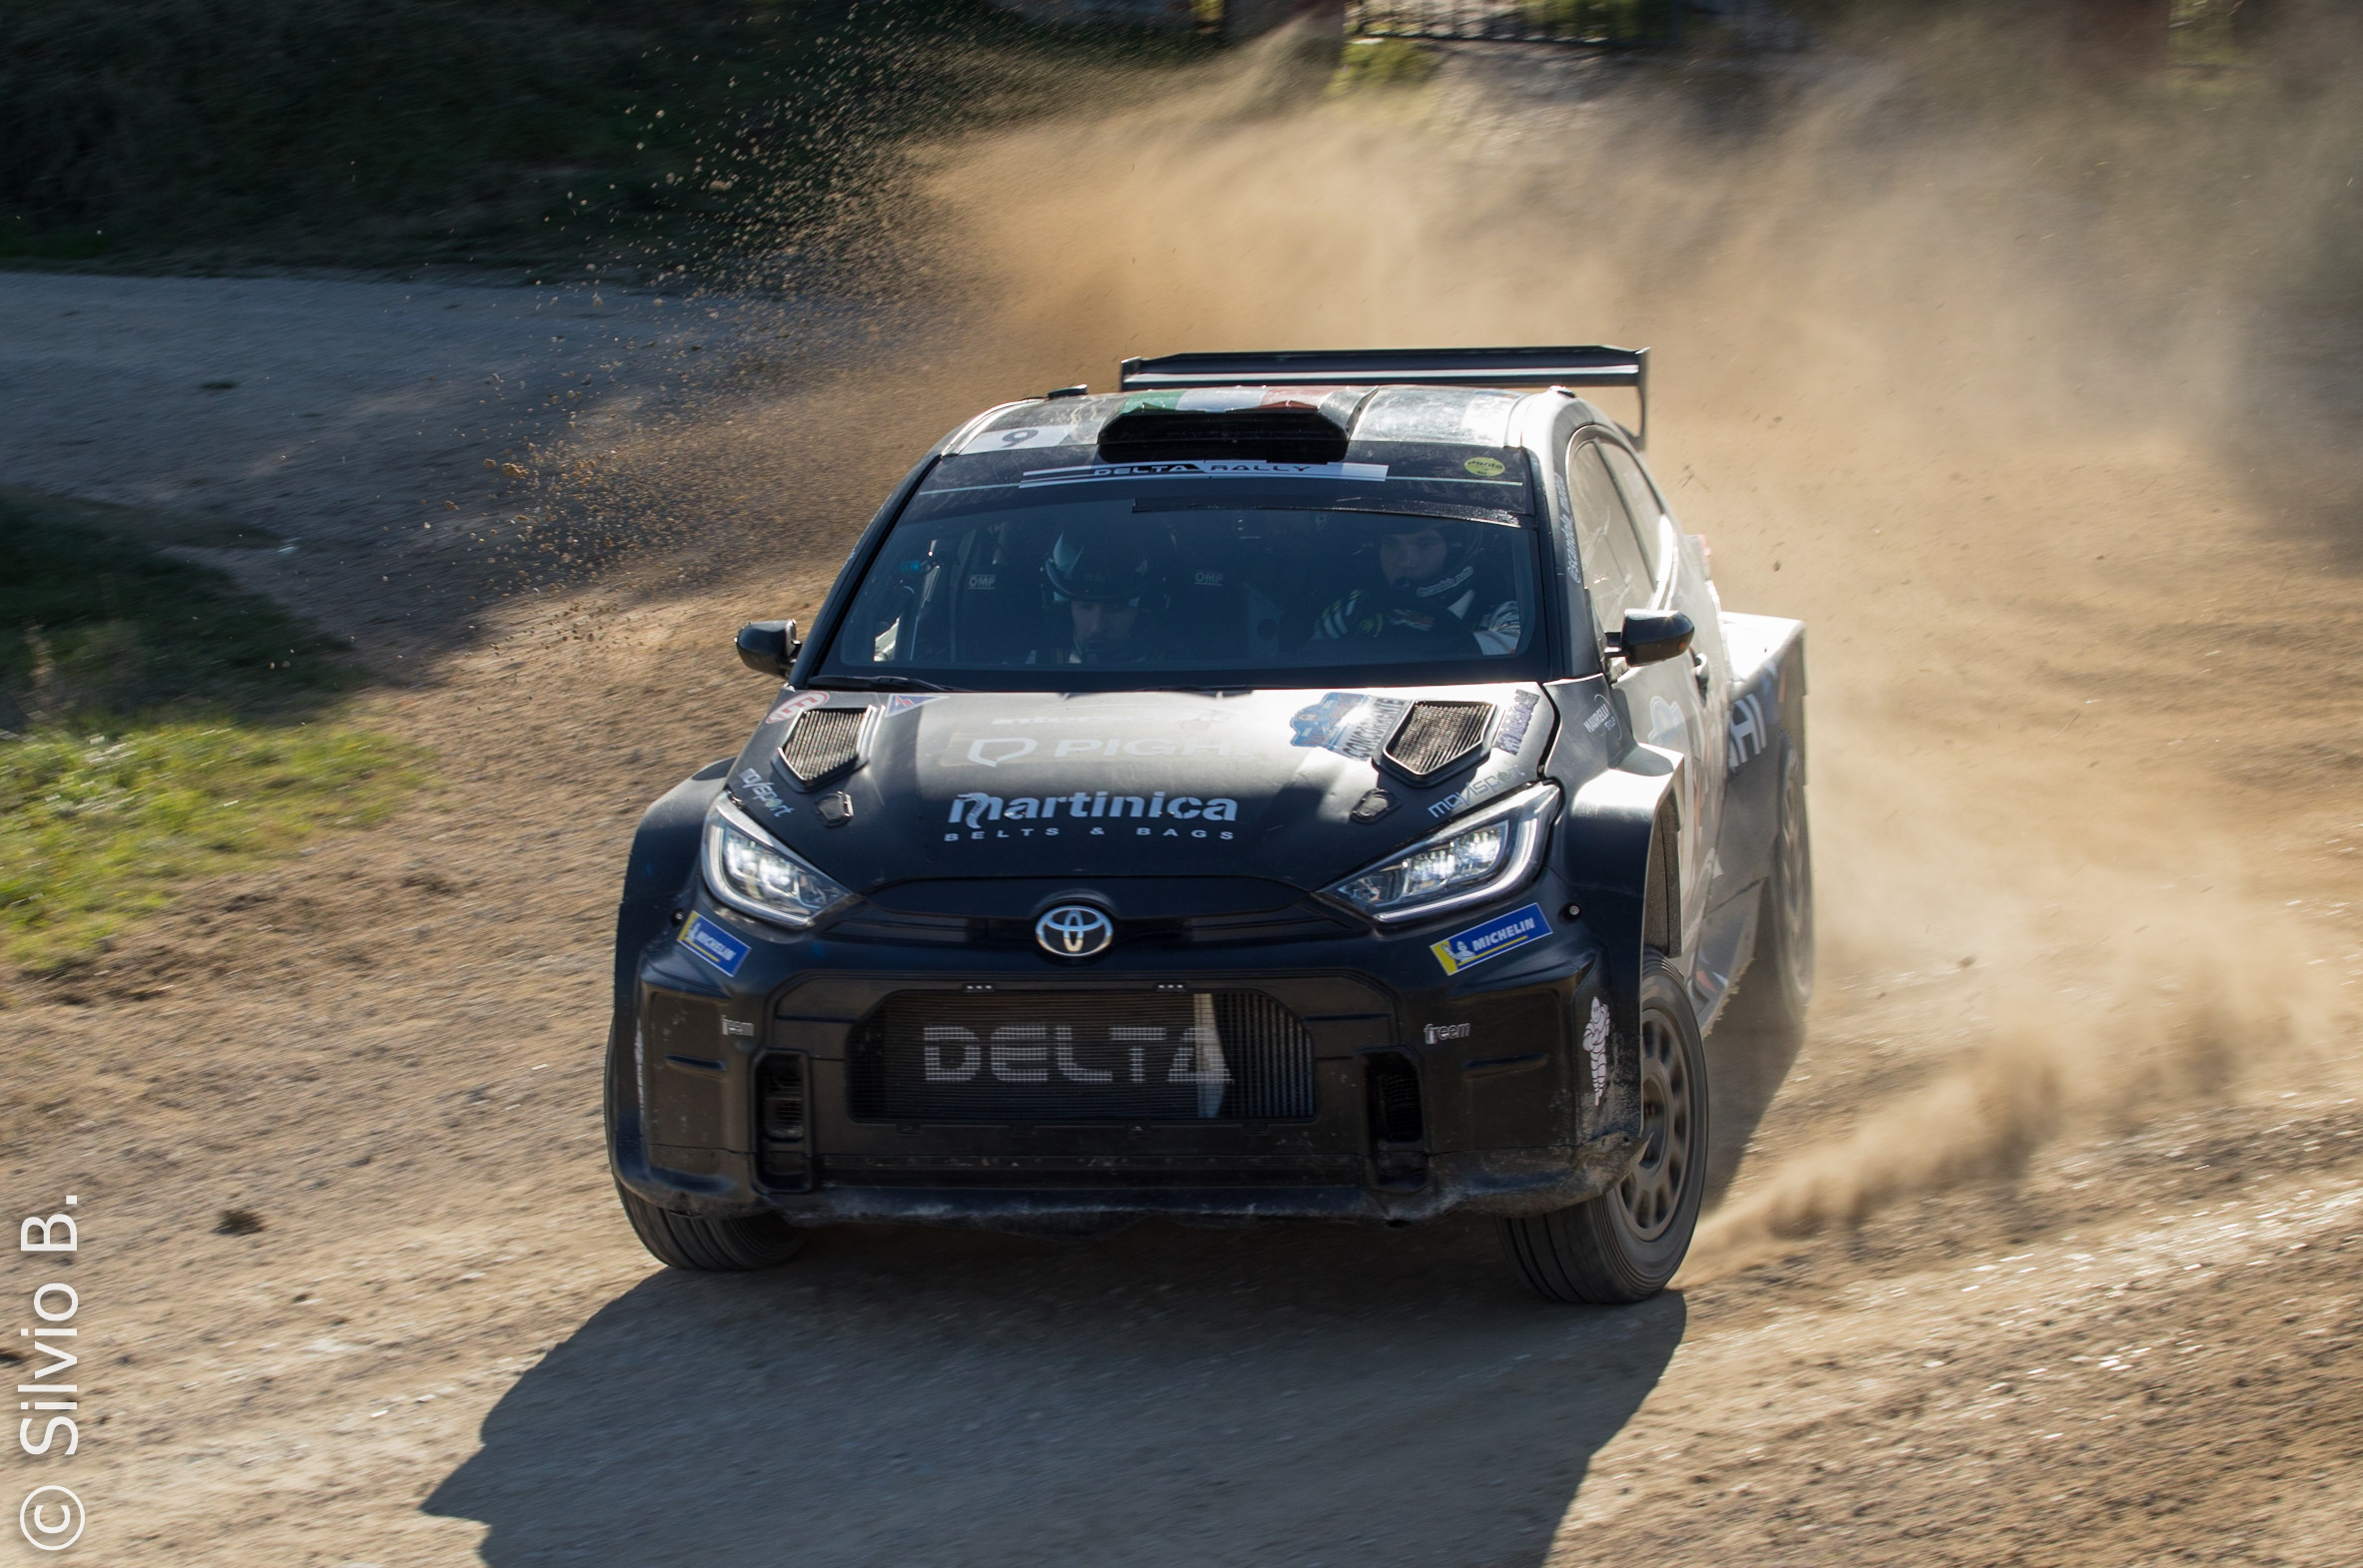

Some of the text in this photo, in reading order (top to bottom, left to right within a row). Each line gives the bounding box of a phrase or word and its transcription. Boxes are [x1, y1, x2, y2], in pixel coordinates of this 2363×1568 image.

[1093, 464, 1312, 477] DELTA RALLY
[967, 576, 996, 588] OMP
[1194, 572, 1224, 584] OMP
[943, 825, 1234, 842] BELTS & BAGS
[1471, 916, 1536, 952] MICHELIN
[1423, 1022, 1472, 1045] freem
[922, 1024, 1235, 1085] DELTA
